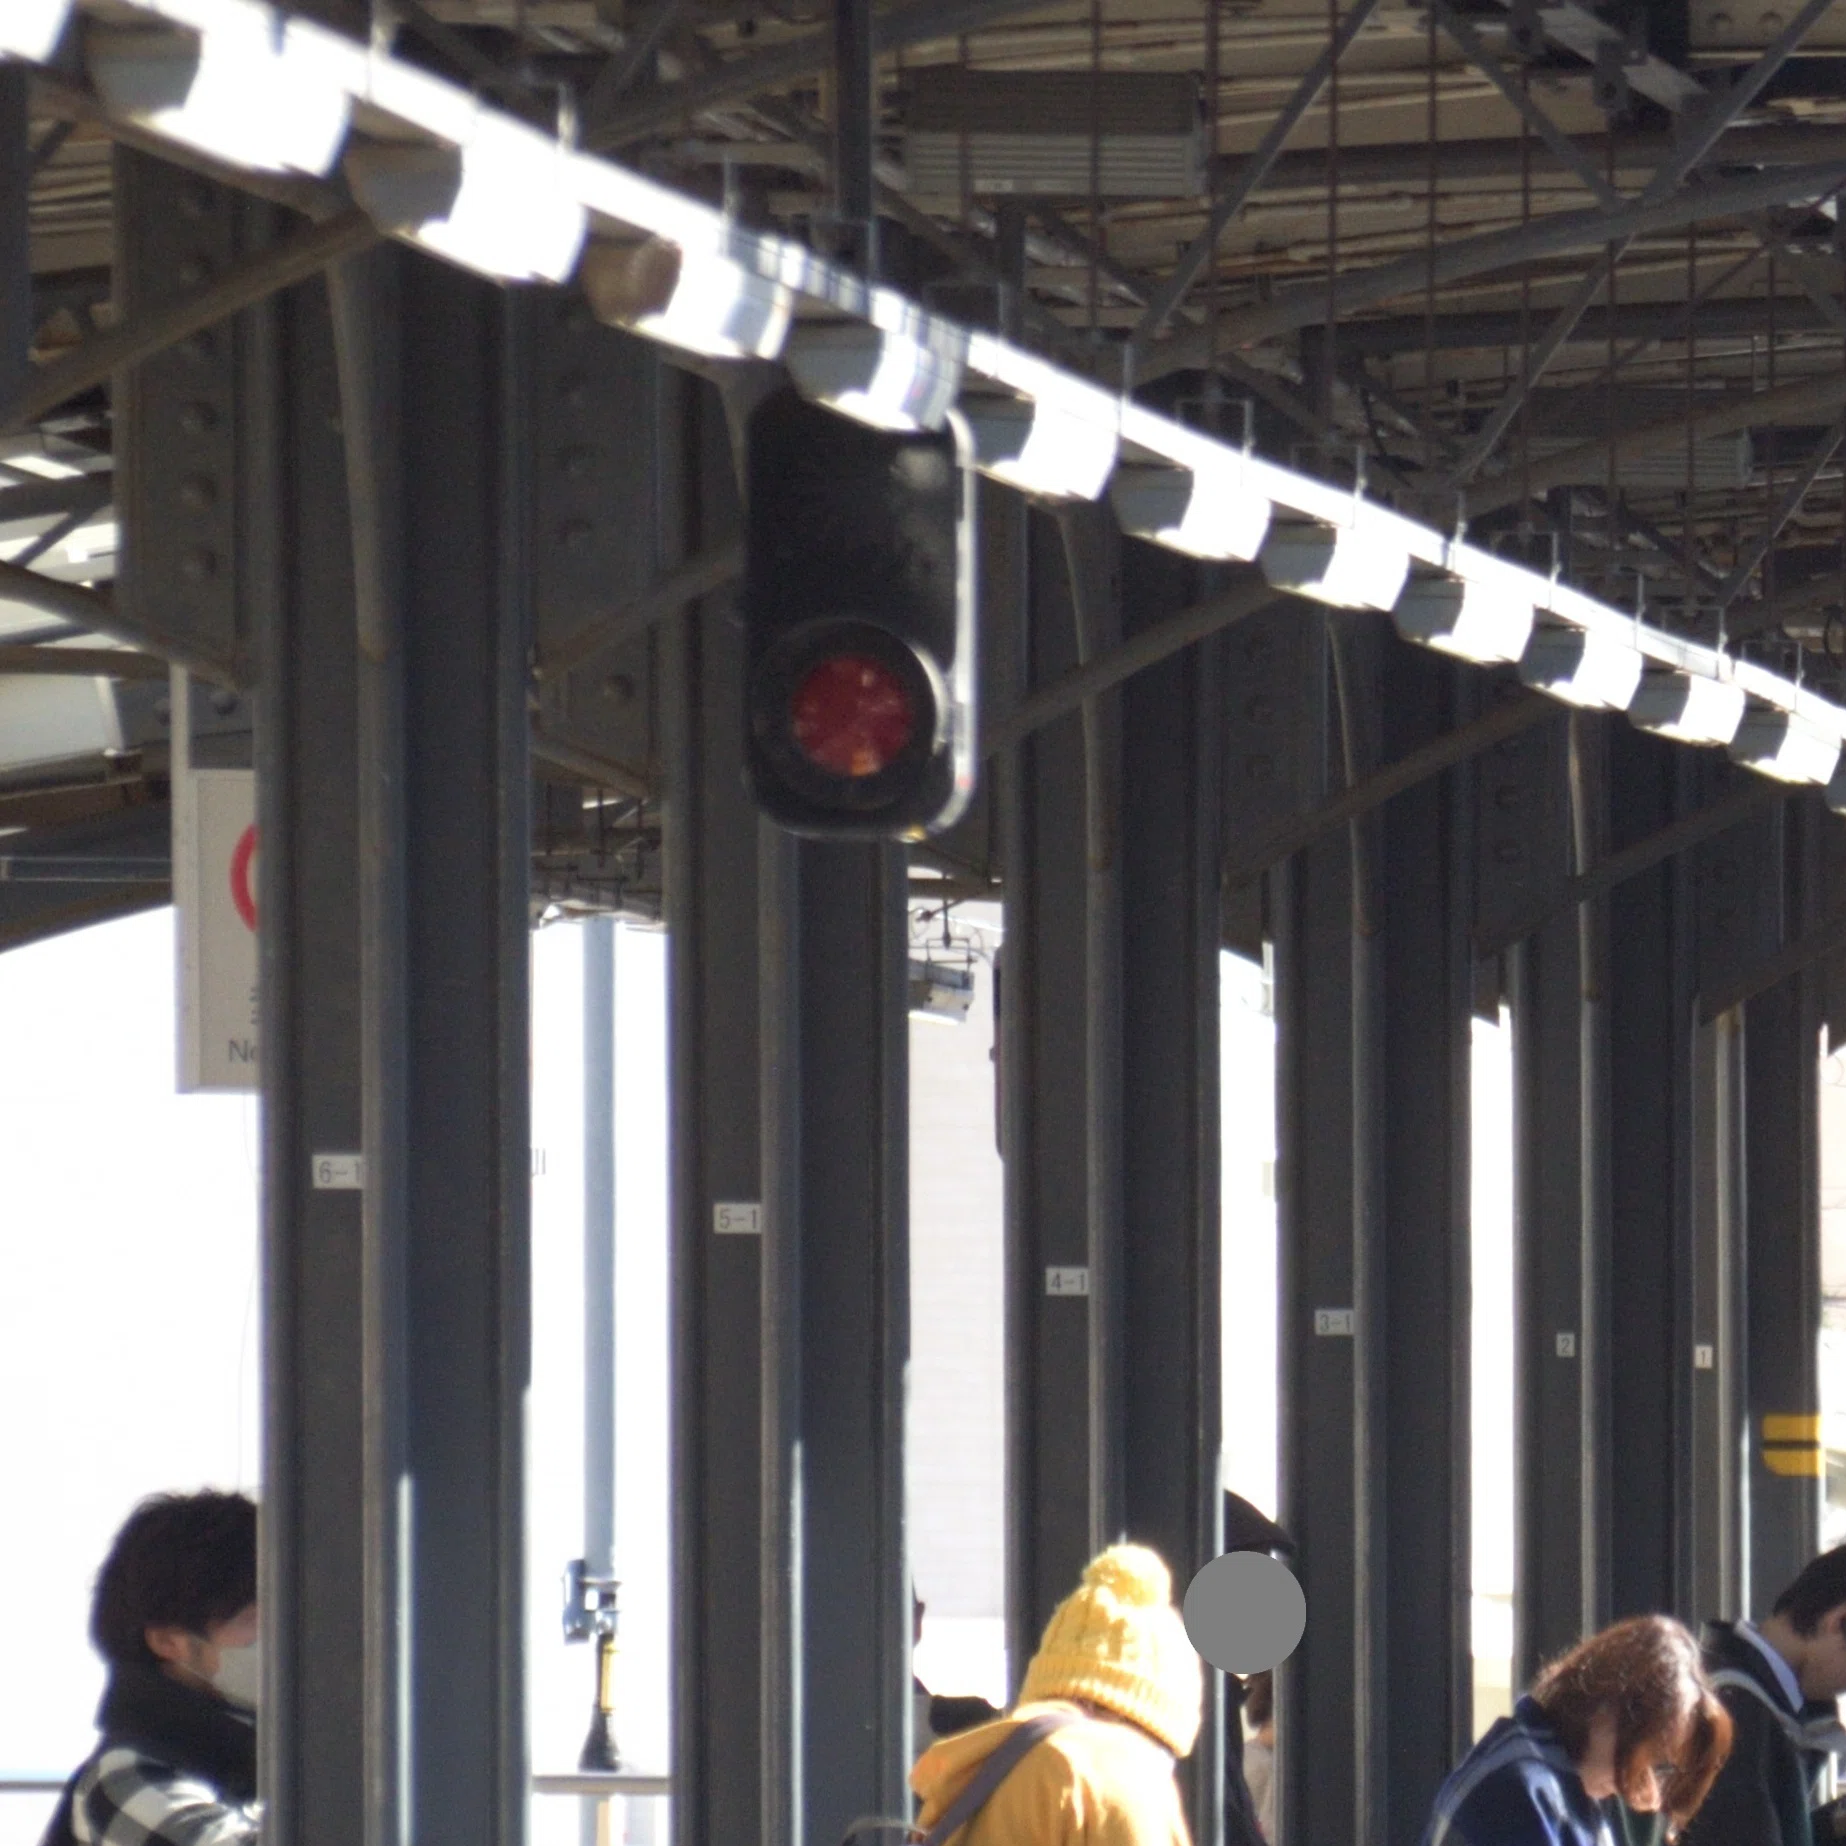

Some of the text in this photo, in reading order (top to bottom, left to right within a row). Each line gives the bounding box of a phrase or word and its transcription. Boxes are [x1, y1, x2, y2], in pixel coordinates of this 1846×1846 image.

[719, 1207, 758, 1230] 5-1
[1050, 1271, 1086, 1293] 4-1
[1320, 1312, 1351, 1333] 3-1
